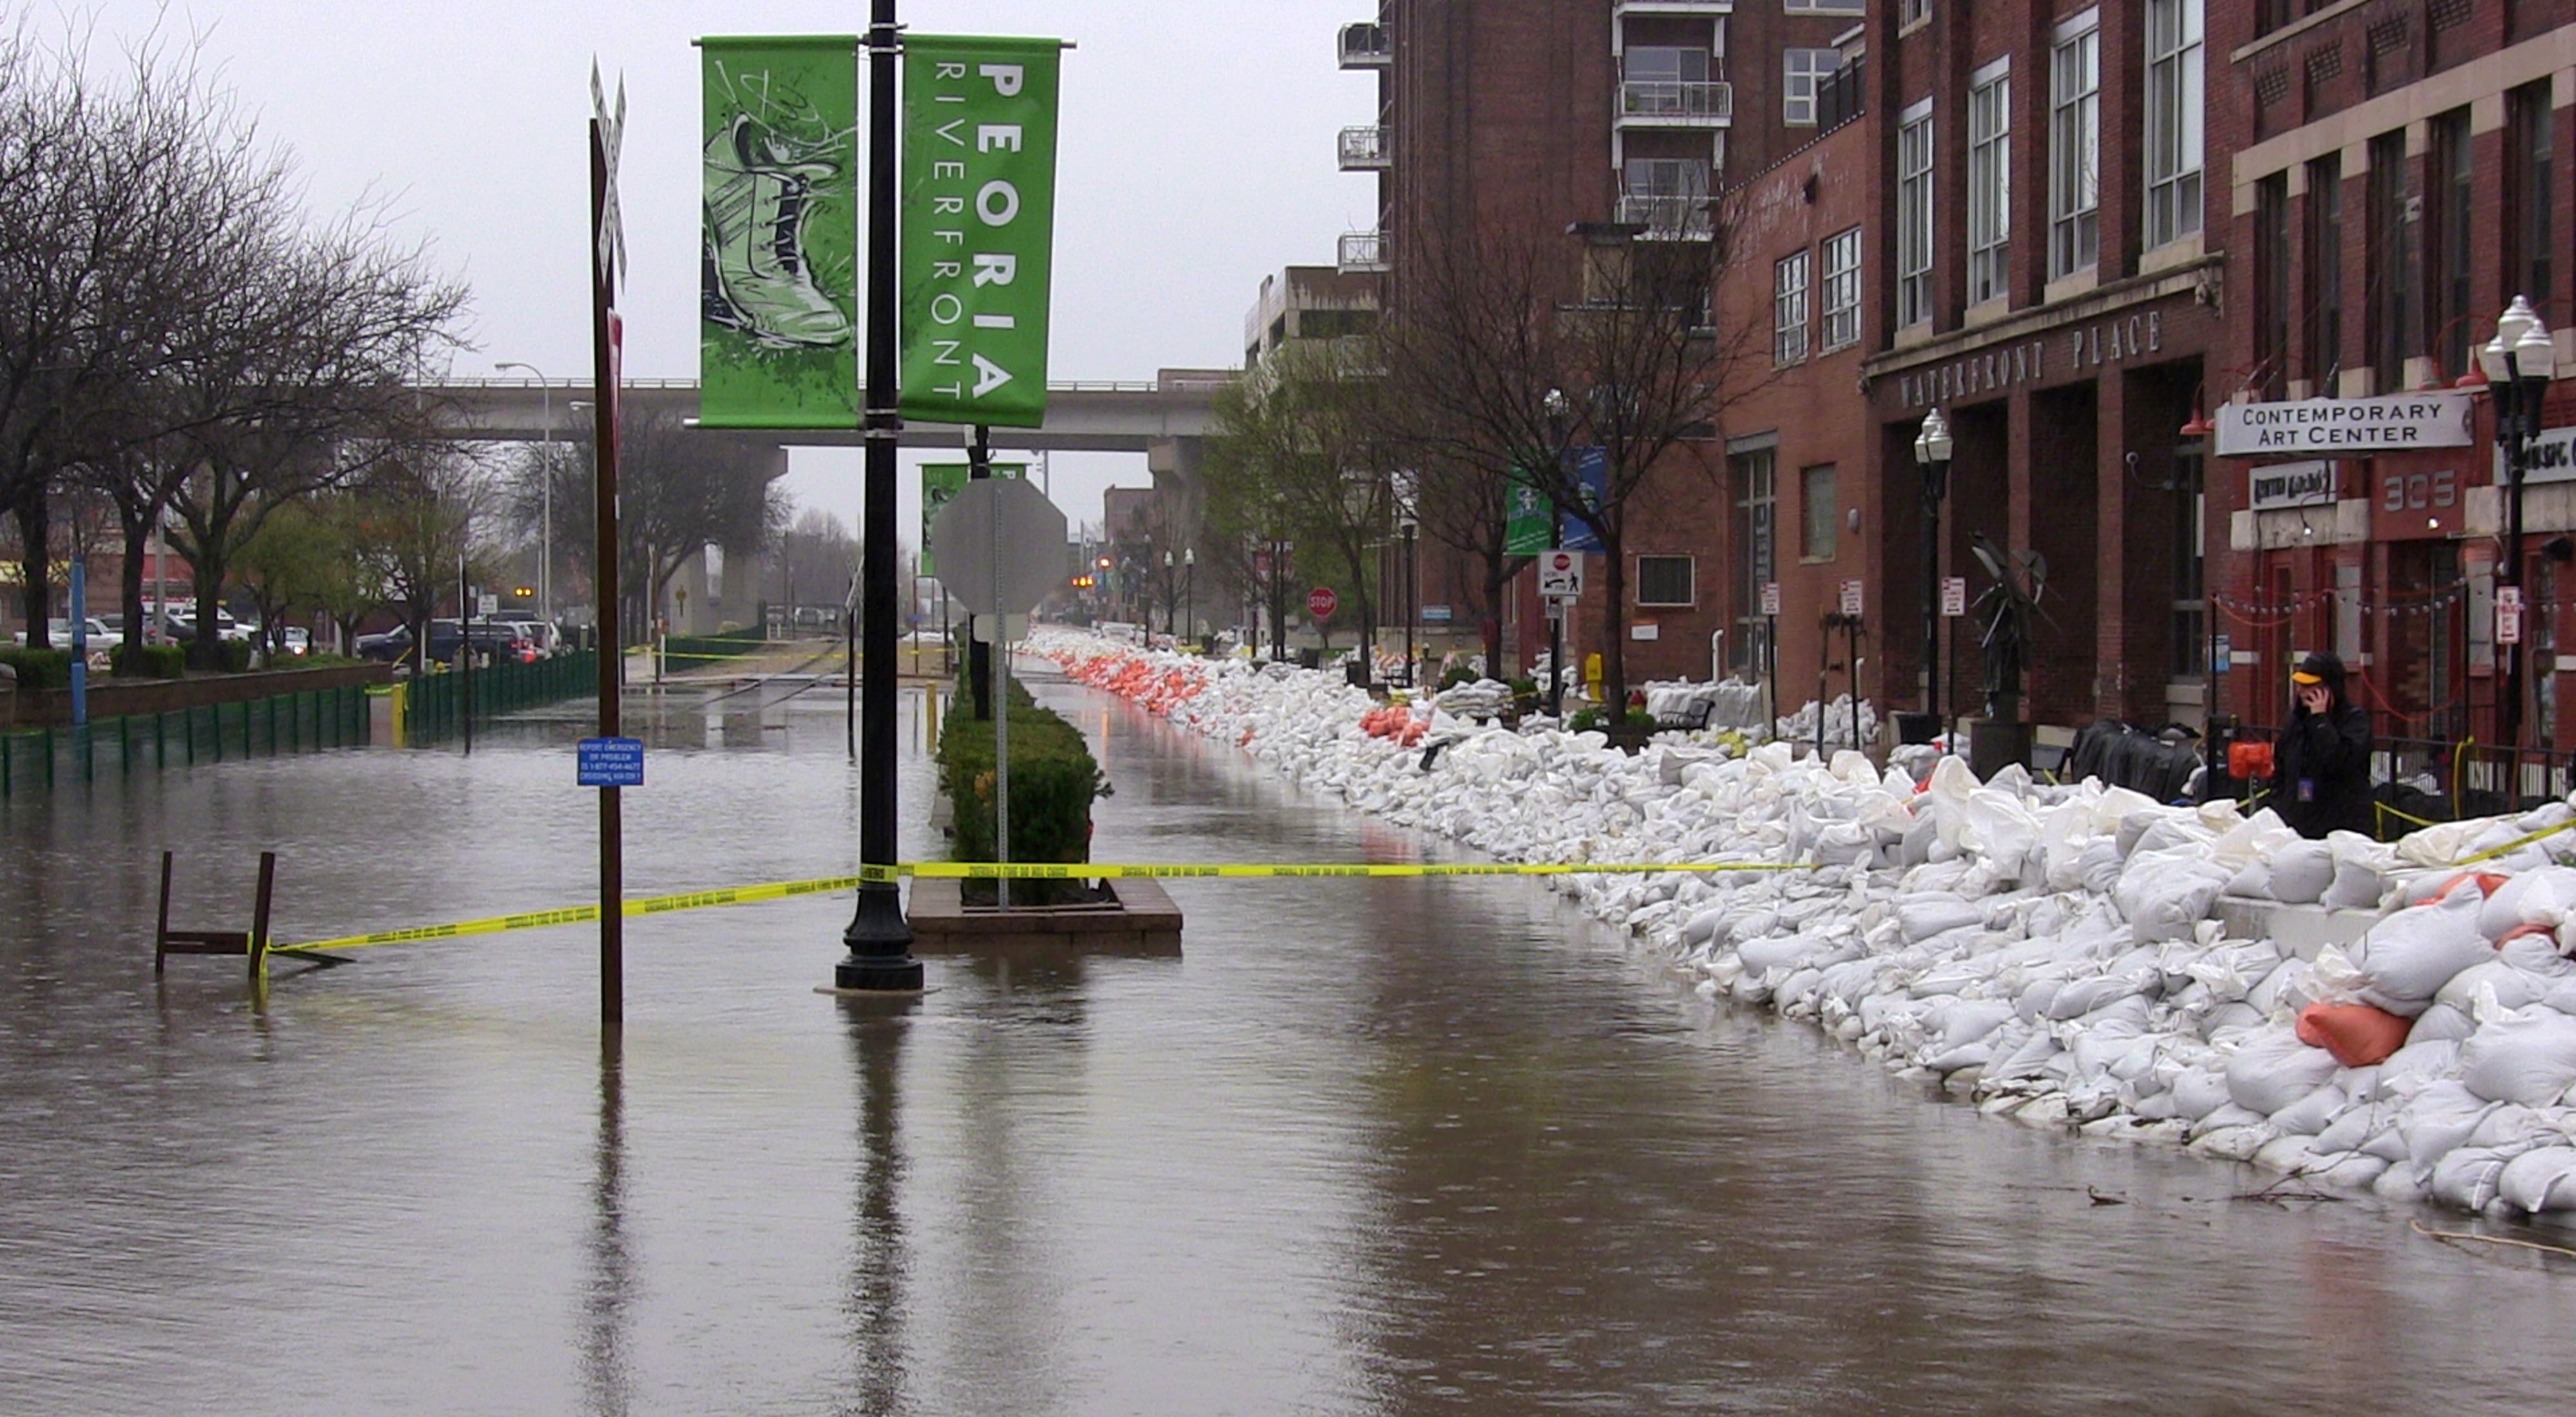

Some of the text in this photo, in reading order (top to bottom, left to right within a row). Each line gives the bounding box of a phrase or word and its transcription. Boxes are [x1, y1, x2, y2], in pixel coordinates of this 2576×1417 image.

[931, 62, 967, 399] RIVERFRONT
[972, 63, 1024, 399] PEORIA
[1900, 310, 2163, 409] WATERFRONT PLACE
[2243, 403, 2442, 426] CONTEMPORARY
[2258, 426, 2418, 446] ART CENTER
[2384, 470, 2456, 512] 305
[1310, 596, 1336, 609] STOP
